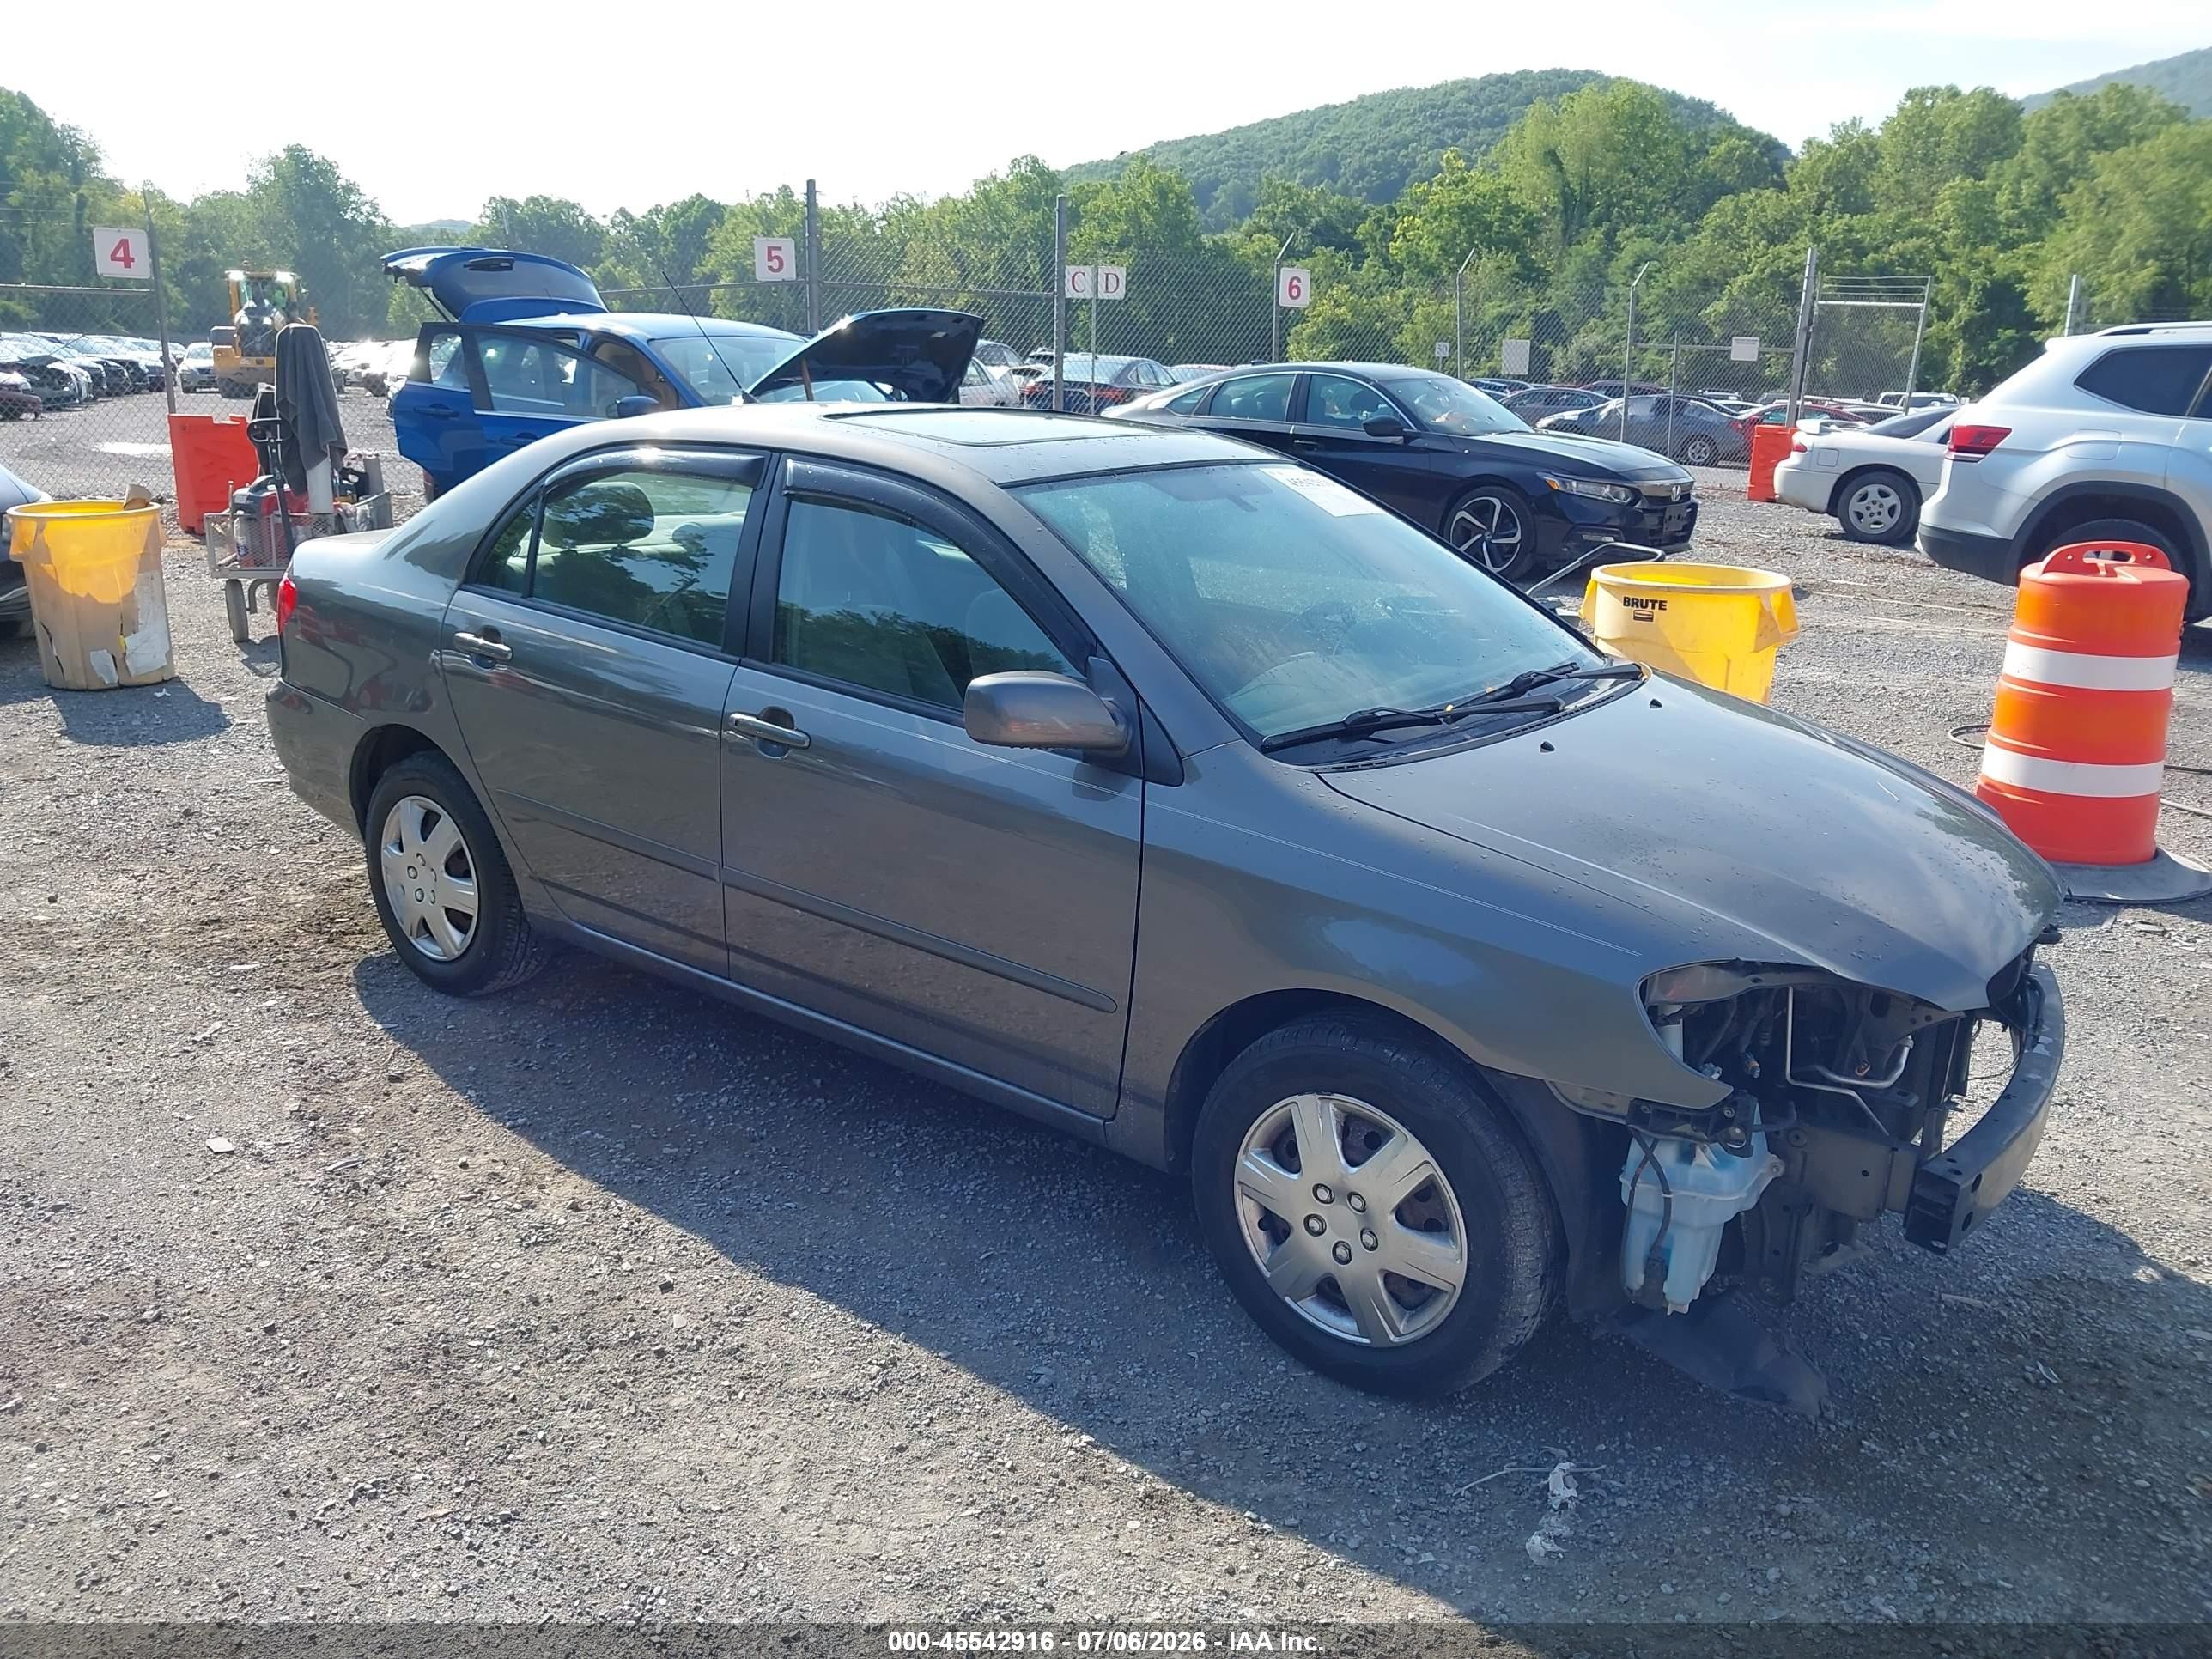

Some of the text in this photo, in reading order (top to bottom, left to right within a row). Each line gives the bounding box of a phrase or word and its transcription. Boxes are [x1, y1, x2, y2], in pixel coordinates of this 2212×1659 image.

[110, 238, 135, 269] 4
[767, 246, 784, 273] 5
[1071, 271, 1086, 293] C
[1103, 272, 1120, 294] D
[1288, 276, 1302, 301] 6
[1623, 596, 1668, 611] BRUTE
